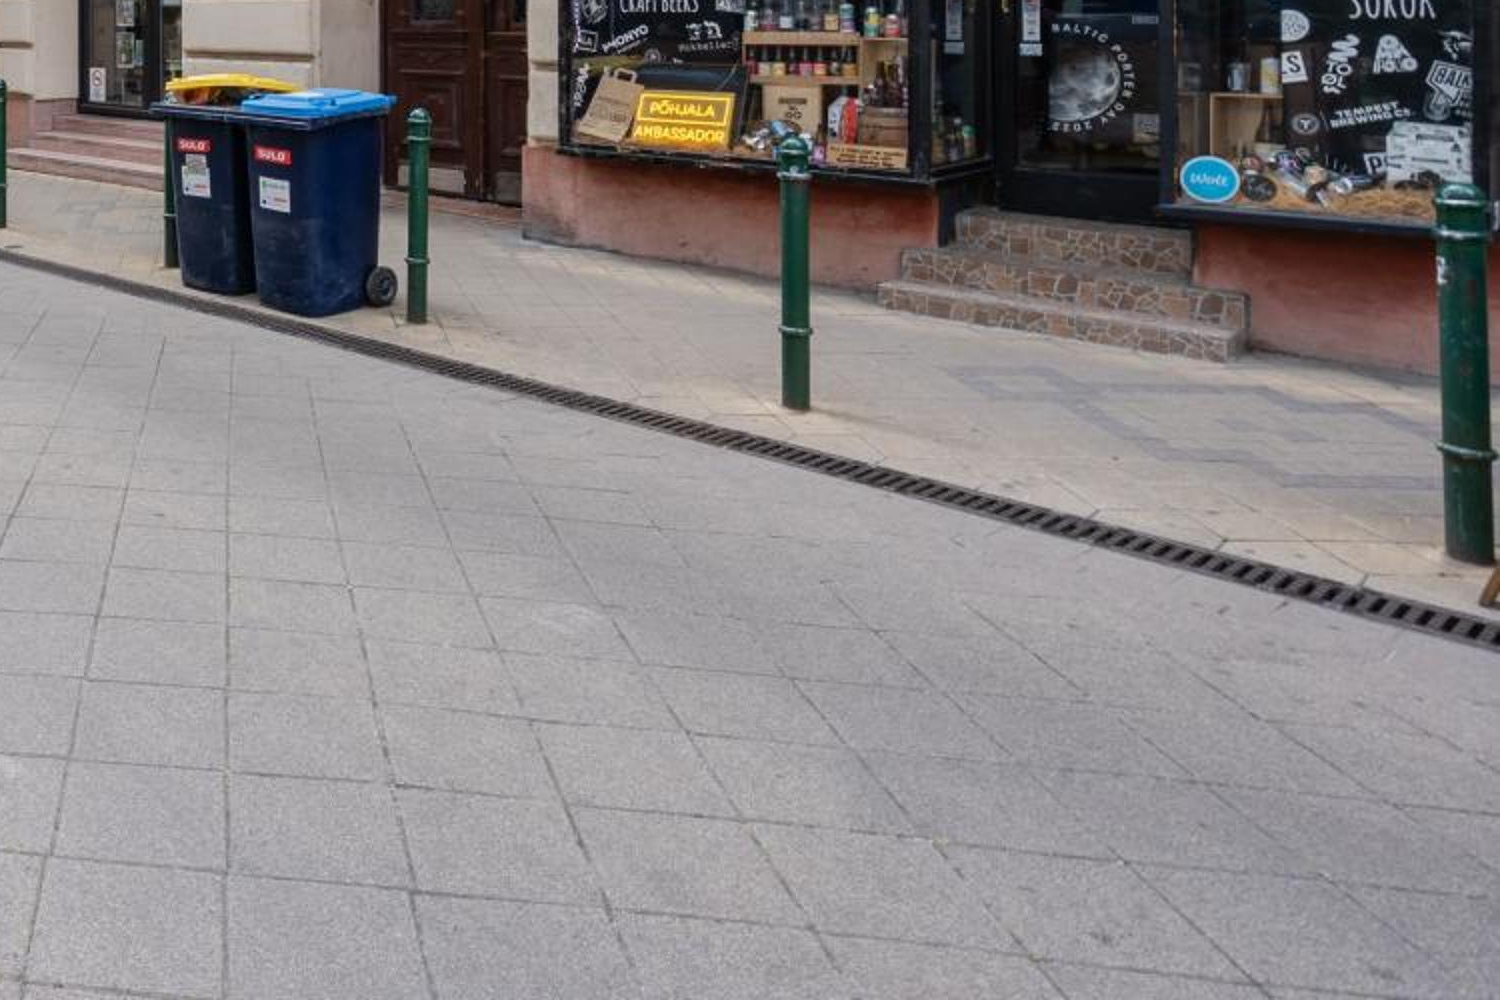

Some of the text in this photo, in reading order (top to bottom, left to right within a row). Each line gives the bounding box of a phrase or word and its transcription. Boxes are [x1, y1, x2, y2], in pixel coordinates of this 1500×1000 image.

[1051, 22, 1109, 44] BALTIC
[649, 100, 715, 118] PÕHJALA
[633, 125, 725, 144] AMBASSADOR
[179, 139, 205, 151] SULO
[258, 150, 286, 162] SULO
